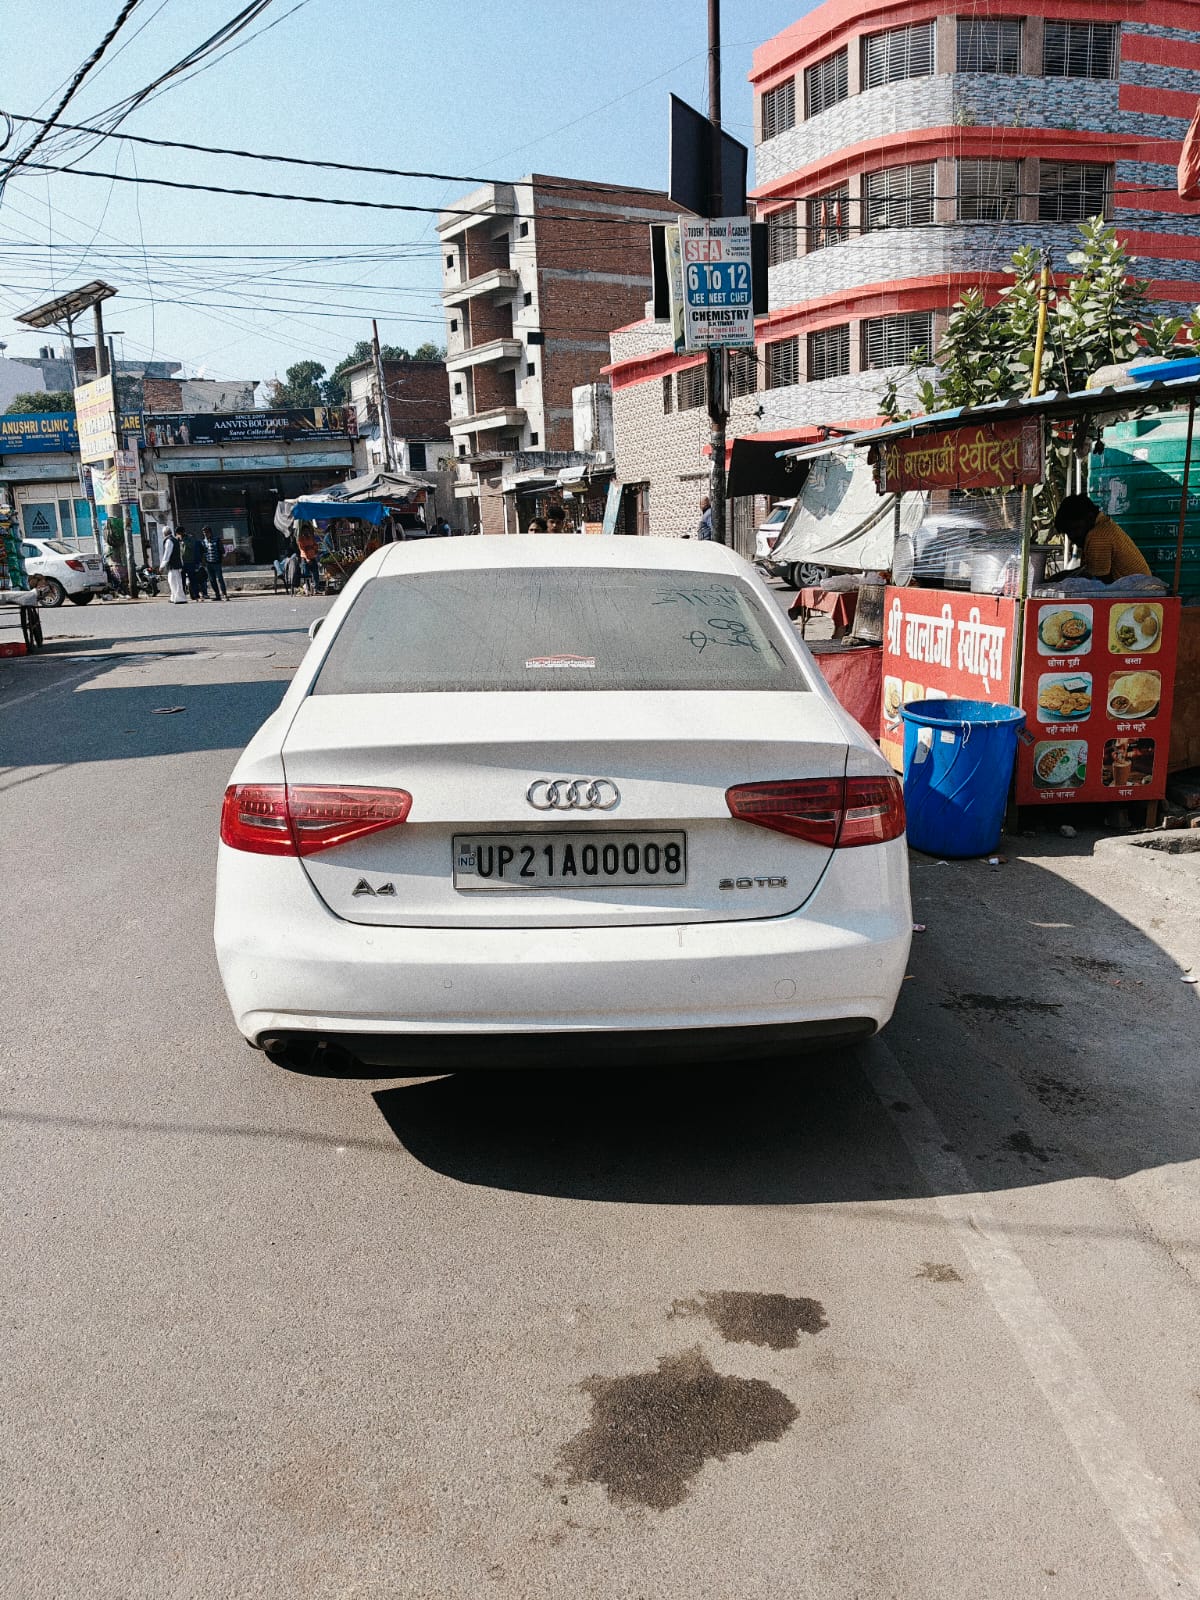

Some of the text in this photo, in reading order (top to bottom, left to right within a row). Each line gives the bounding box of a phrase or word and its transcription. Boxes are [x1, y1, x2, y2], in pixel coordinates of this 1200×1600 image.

[687, 241, 720, 261] SFA
[688, 265, 699, 290] 6
[727, 264, 748, 289] 12
[691, 291, 748, 304] JEE NEET CUET
[692, 310, 750, 321] CHEMISTRY
[2, 420, 39, 434] ANUSHRI
[41, 419, 69, 433] CLINIC
[246, 428, 276, 436] Collection
[248, 418, 289, 429] BOUTIQUE
[886, 444, 901, 480] श्री
[903, 433, 956, 479] बालाजी
[887, 597, 1006, 695] श्री बालाजी स्वीट्स
[457, 842, 681, 878] IND UP21AQ0008
[351, 877, 396, 897] A4
